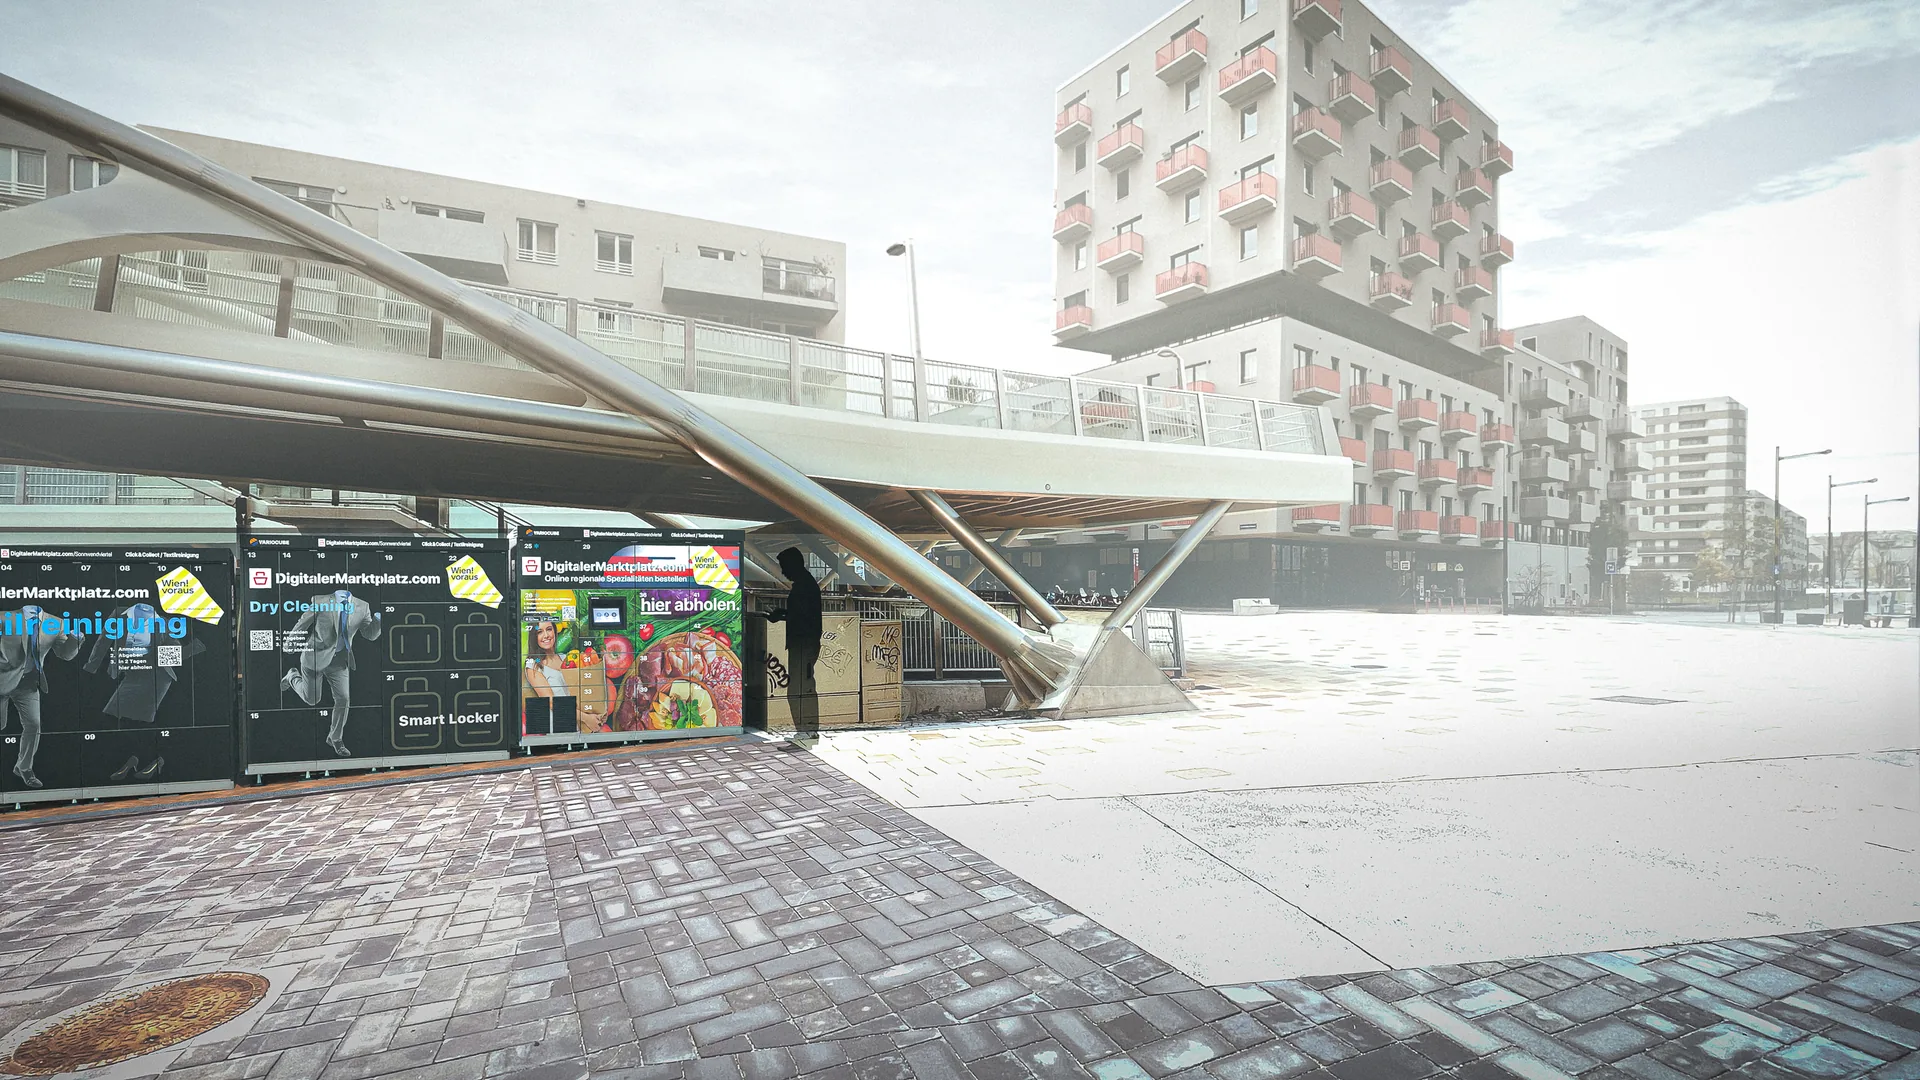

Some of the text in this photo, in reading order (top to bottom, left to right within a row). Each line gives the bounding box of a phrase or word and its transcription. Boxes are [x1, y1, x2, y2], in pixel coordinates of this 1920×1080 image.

[544, 560, 686, 573] DigitalerMarktplatz.com
[276, 572, 440, 586] DigitalerMarktplatz.com
[570, 575, 605, 583] regionale
[606, 575, 653, 584] Spezialitäten
[250, 600, 354, 614] Dry Cleaning
[641, 598, 740, 612] hier abholen.
[399, 712, 499, 726] Smart Locker
